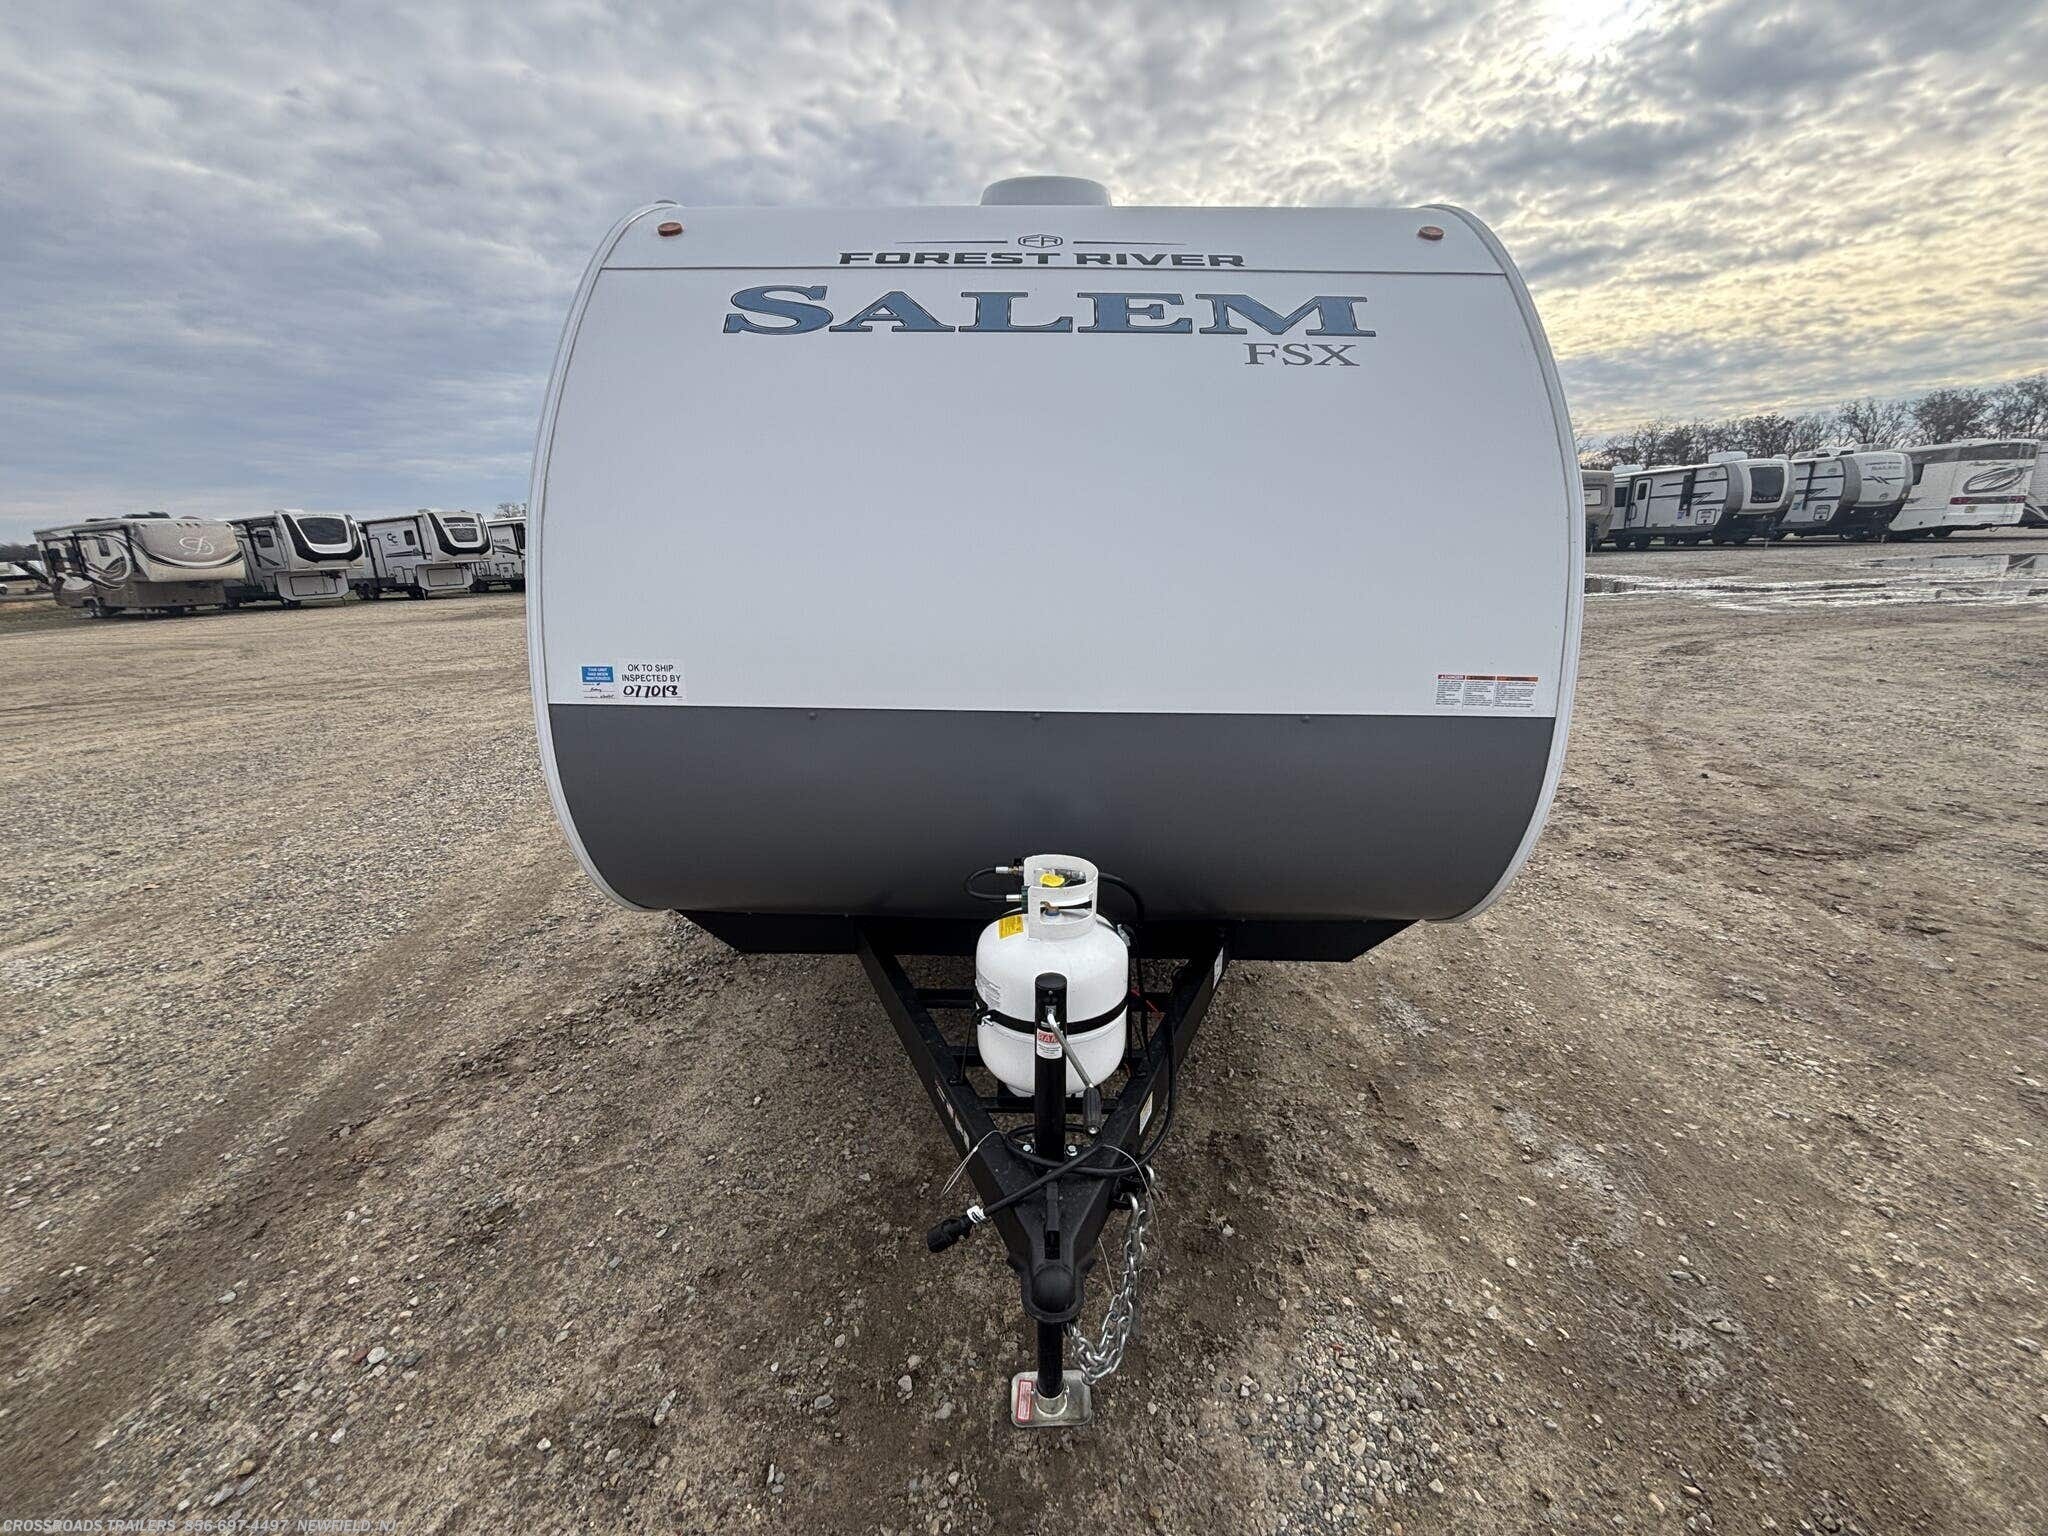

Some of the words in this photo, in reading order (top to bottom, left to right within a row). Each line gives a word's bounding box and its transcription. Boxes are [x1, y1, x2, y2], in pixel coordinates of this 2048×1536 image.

[839, 252, 1060, 265] FOREST
[1073, 252, 1245, 267] RIVER
[723, 284, 1376, 337] SALEM
[1243, 342, 1360, 366] FSX
[627, 664, 640, 672] OK
[642, 664, 653, 672] TO
[655, 664, 674, 673] SHIP
[621, 674, 667, 682] INSPECTED
[669, 674, 681, 682] BY
